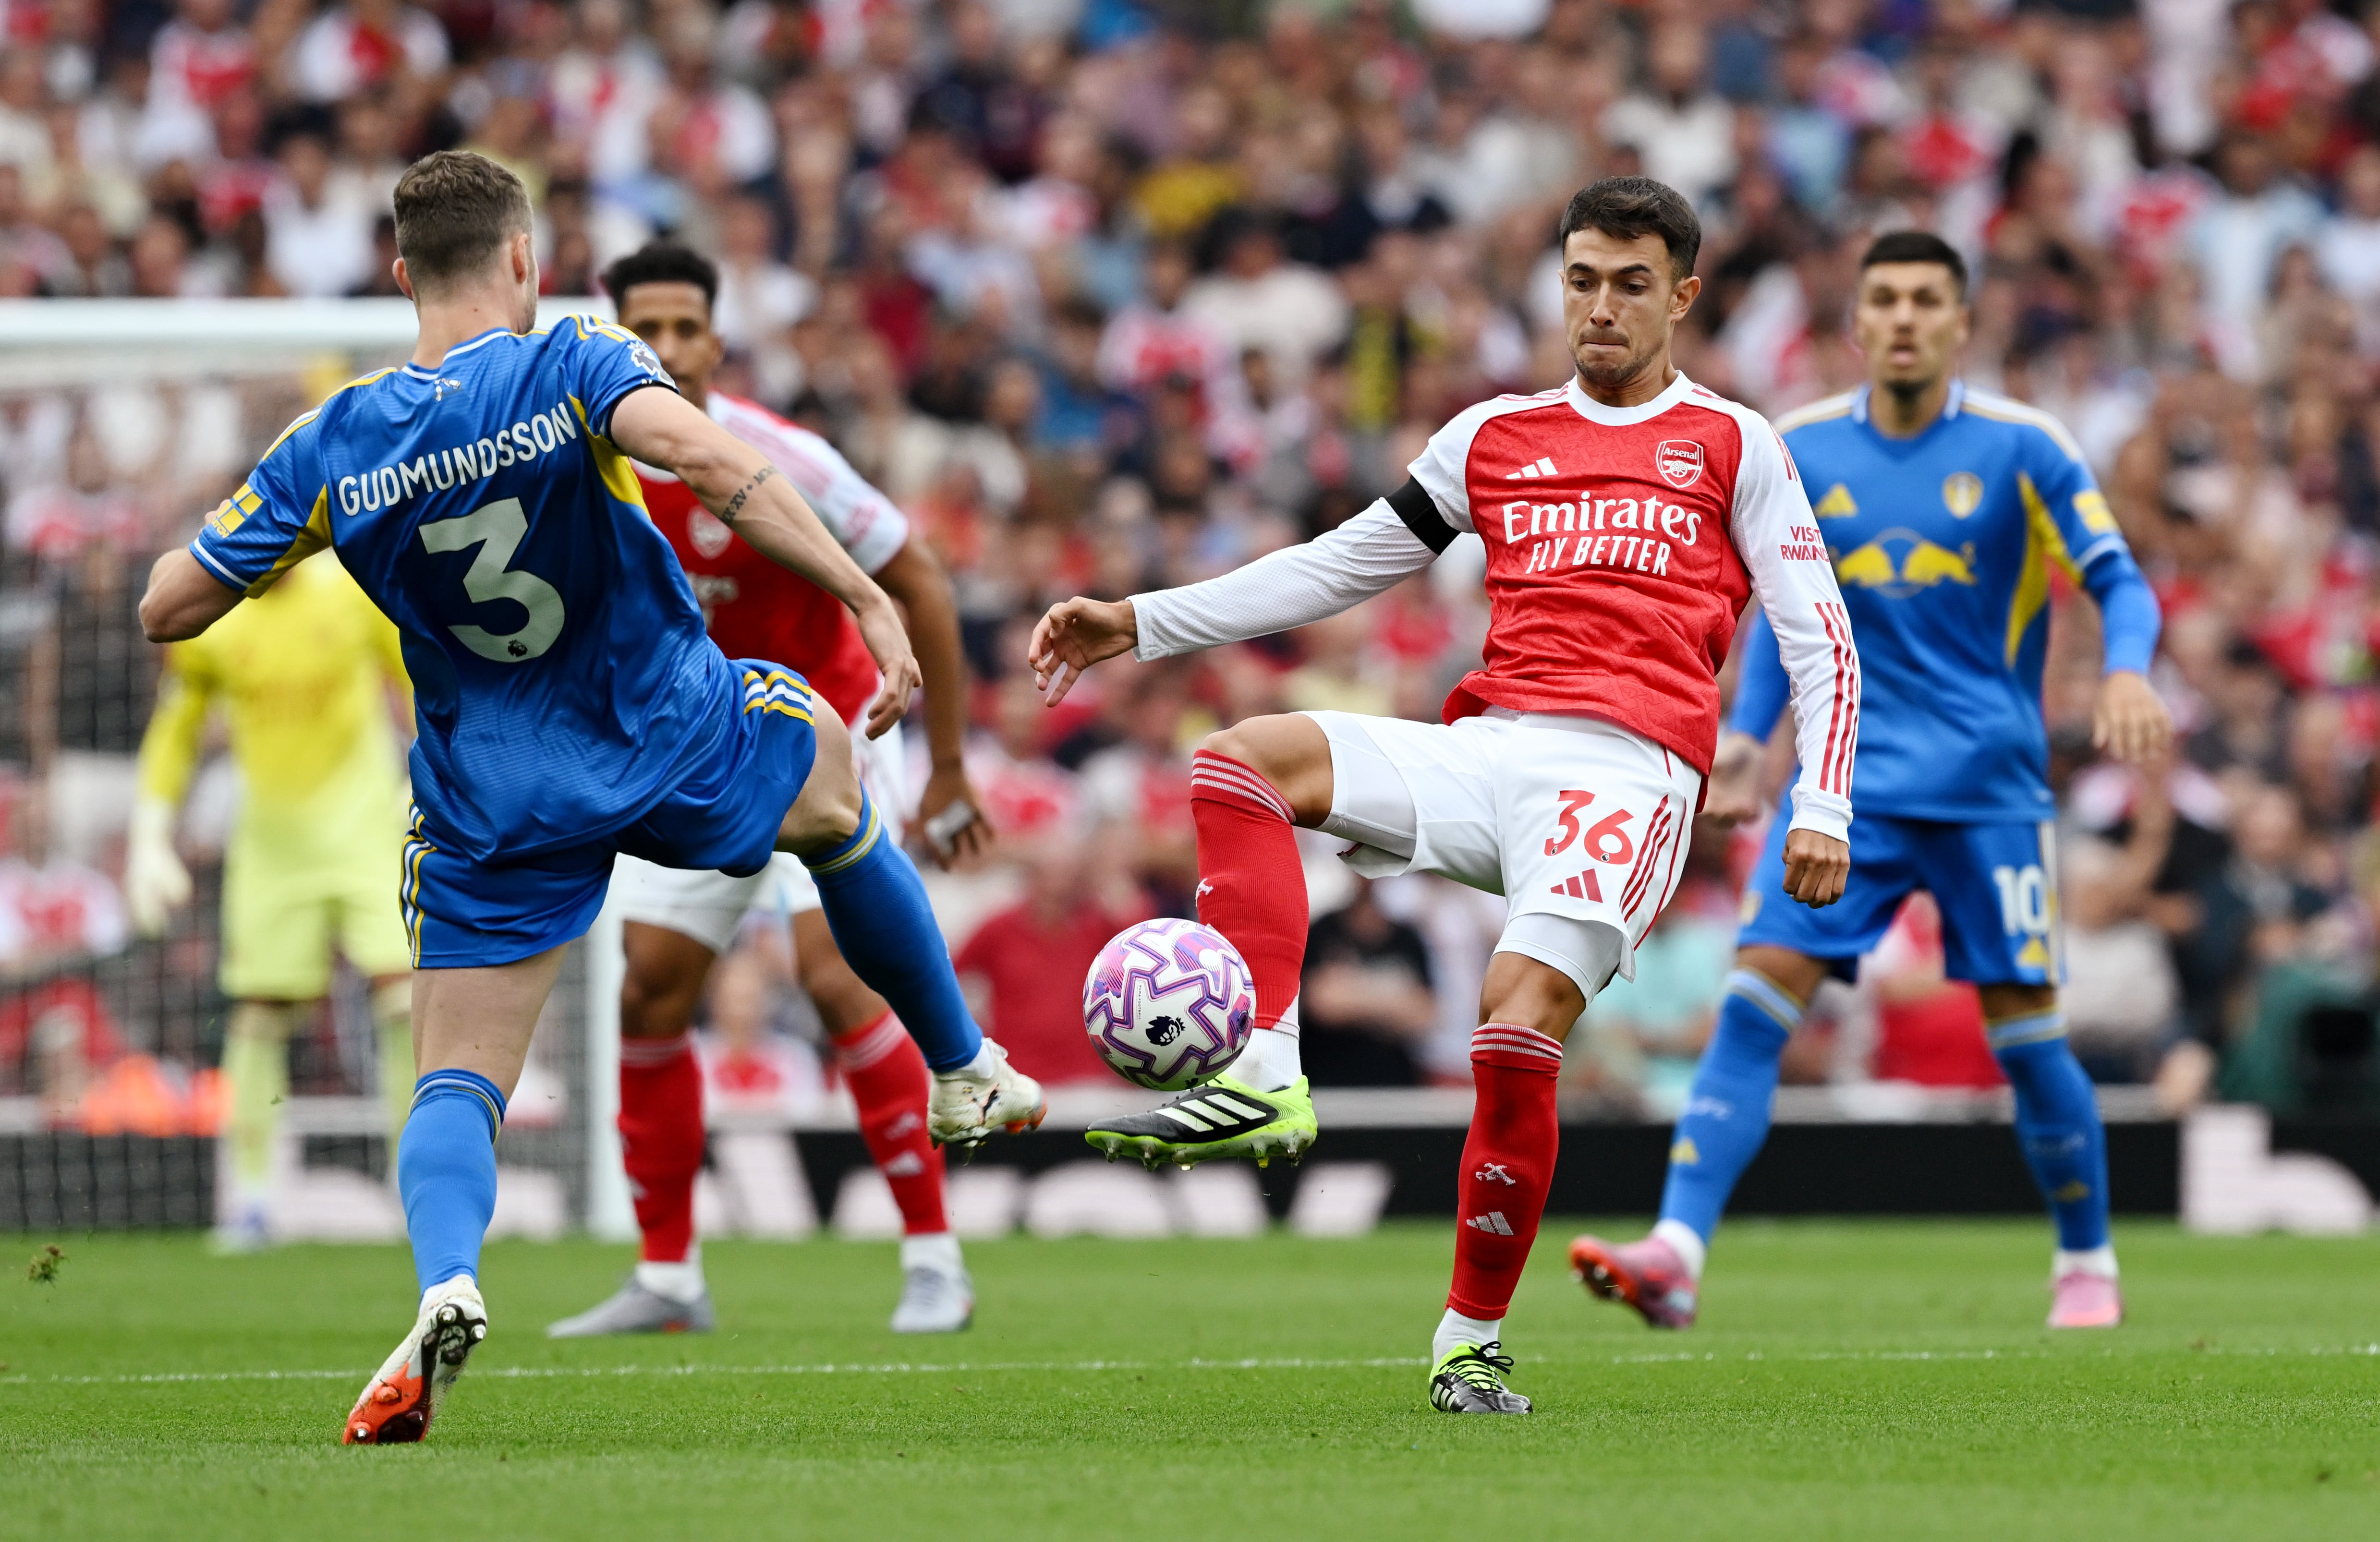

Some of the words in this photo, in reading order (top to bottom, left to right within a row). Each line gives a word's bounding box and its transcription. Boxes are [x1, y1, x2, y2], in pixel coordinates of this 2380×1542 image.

[339, 402, 576, 517] GUDMUNDSSON
[1663, 447, 1698, 460] Arsenal
[1502, 491, 1702, 546] Emirates
[1790, 526, 1821, 544] VISIT
[418, 496, 565, 663] 3
[1525, 537, 1568, 575] FLY
[1572, 535, 1671, 577] BETTER
[1780, 544, 1829, 563] RWAND
[1543, 790, 1634, 865] 36
[1993, 865, 2050, 936] 10
